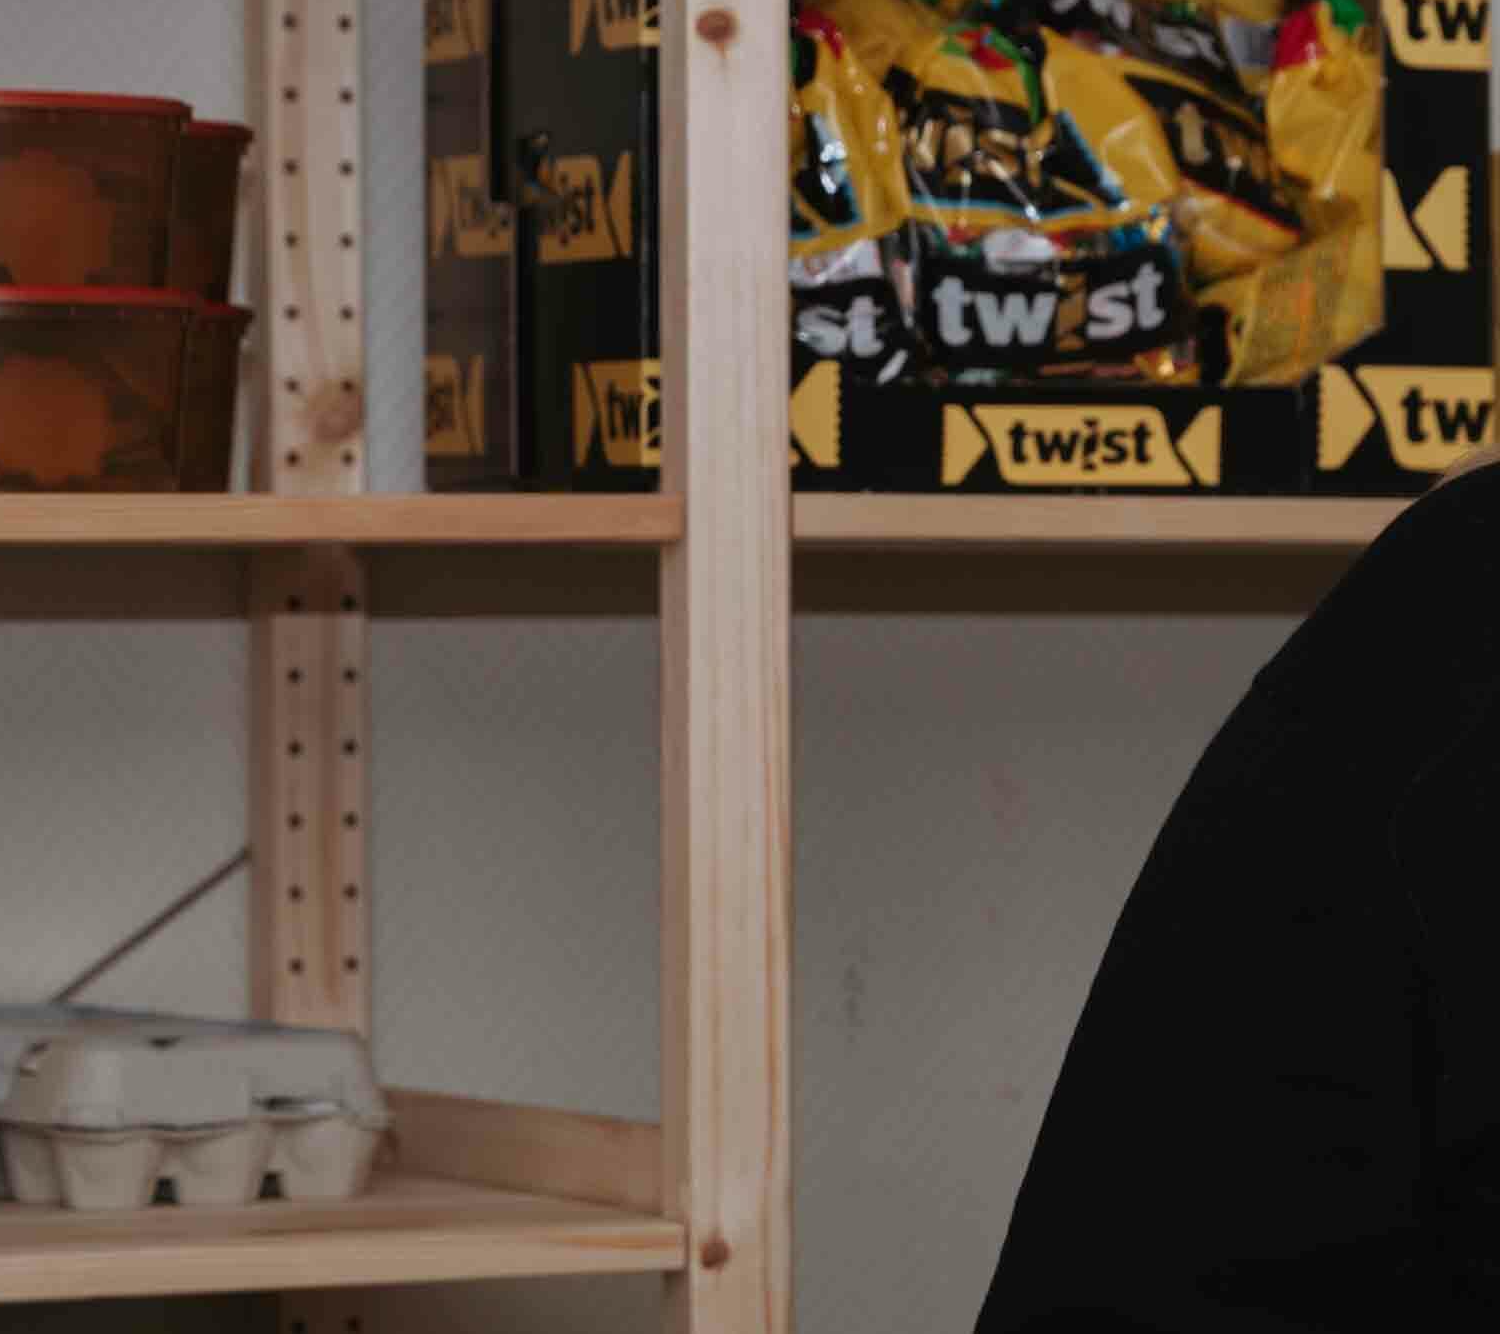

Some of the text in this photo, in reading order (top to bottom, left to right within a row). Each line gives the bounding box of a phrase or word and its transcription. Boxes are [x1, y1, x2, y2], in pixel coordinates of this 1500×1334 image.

[932, 263, 1166, 353] twist
[1008, 419, 1152, 470] twist
[1401, 386, 1493, 445] tw
